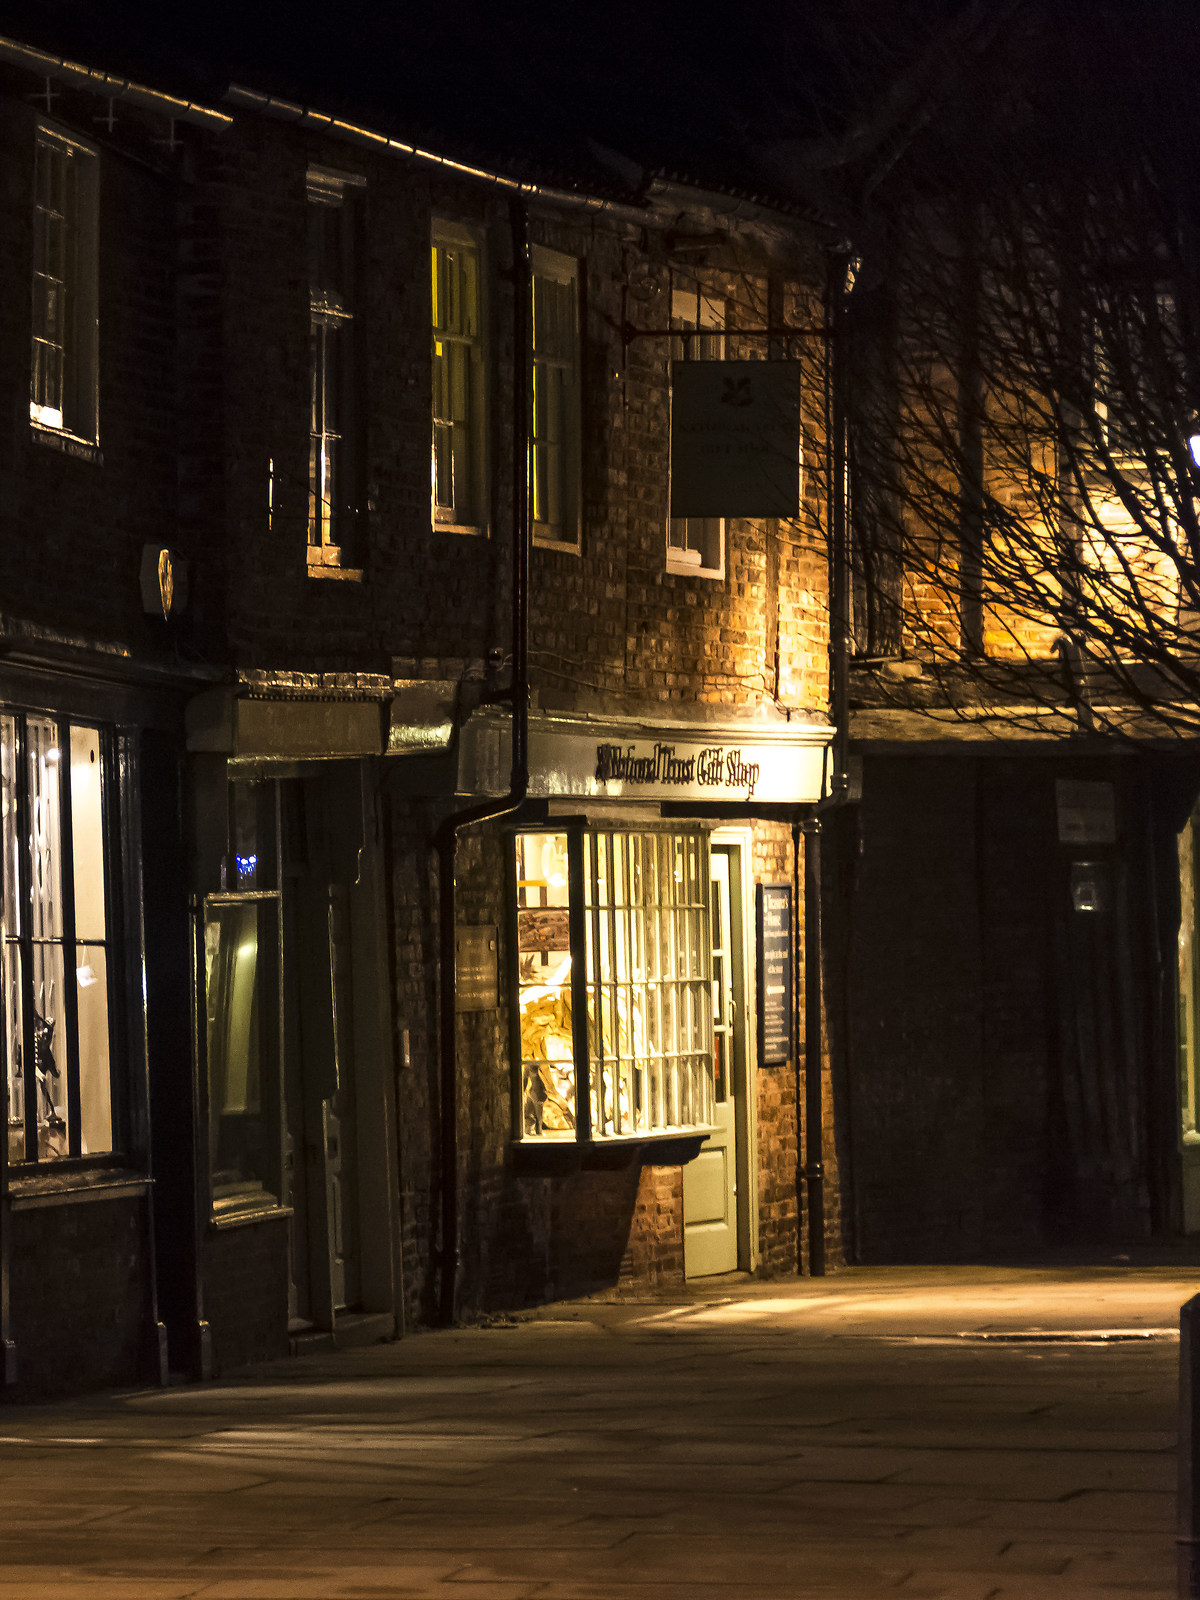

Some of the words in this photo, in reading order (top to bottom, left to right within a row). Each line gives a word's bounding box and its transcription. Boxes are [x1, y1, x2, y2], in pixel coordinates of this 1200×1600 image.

[603, 743, 661, 784] National
[660, 745, 696, 785] Trust
[697, 746, 724, 787] Gift
[725, 748, 761, 802] Shop
